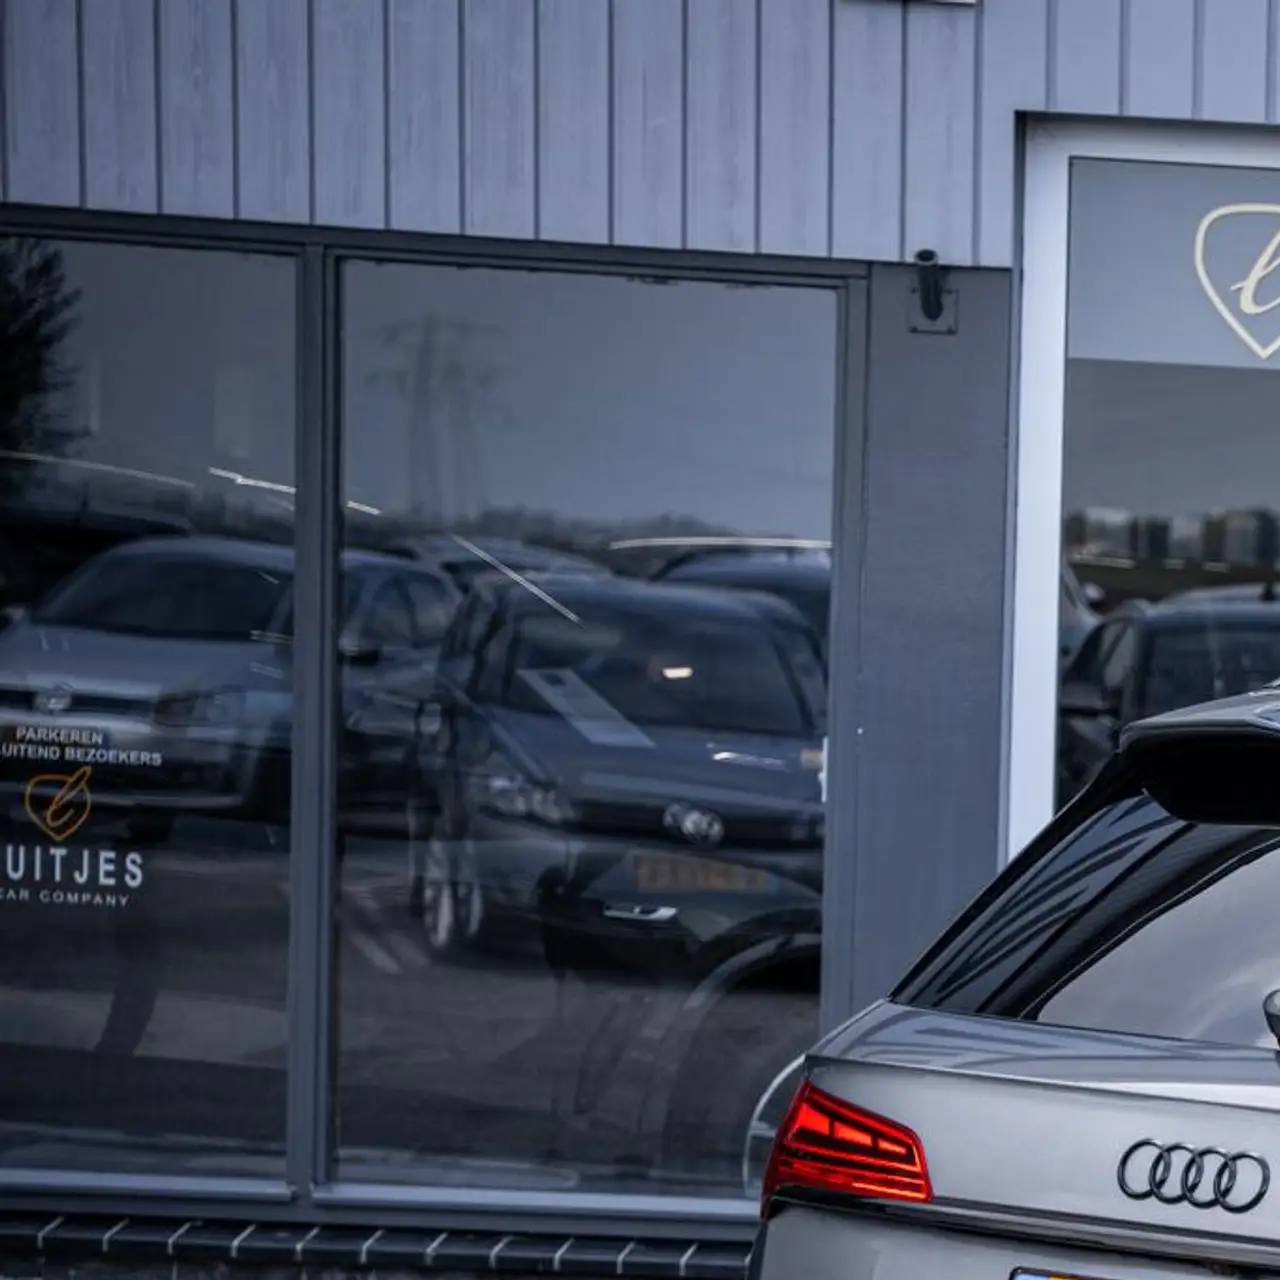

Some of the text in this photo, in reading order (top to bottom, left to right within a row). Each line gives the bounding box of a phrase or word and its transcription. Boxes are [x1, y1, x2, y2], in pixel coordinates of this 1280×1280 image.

[15, 726, 103, 745] PARKEREN
[0, 743, 163, 767] UITEND BEZOEKERS
[6, 845, 144, 888] UITJES
[38, 888, 130, 908] COMPANY
